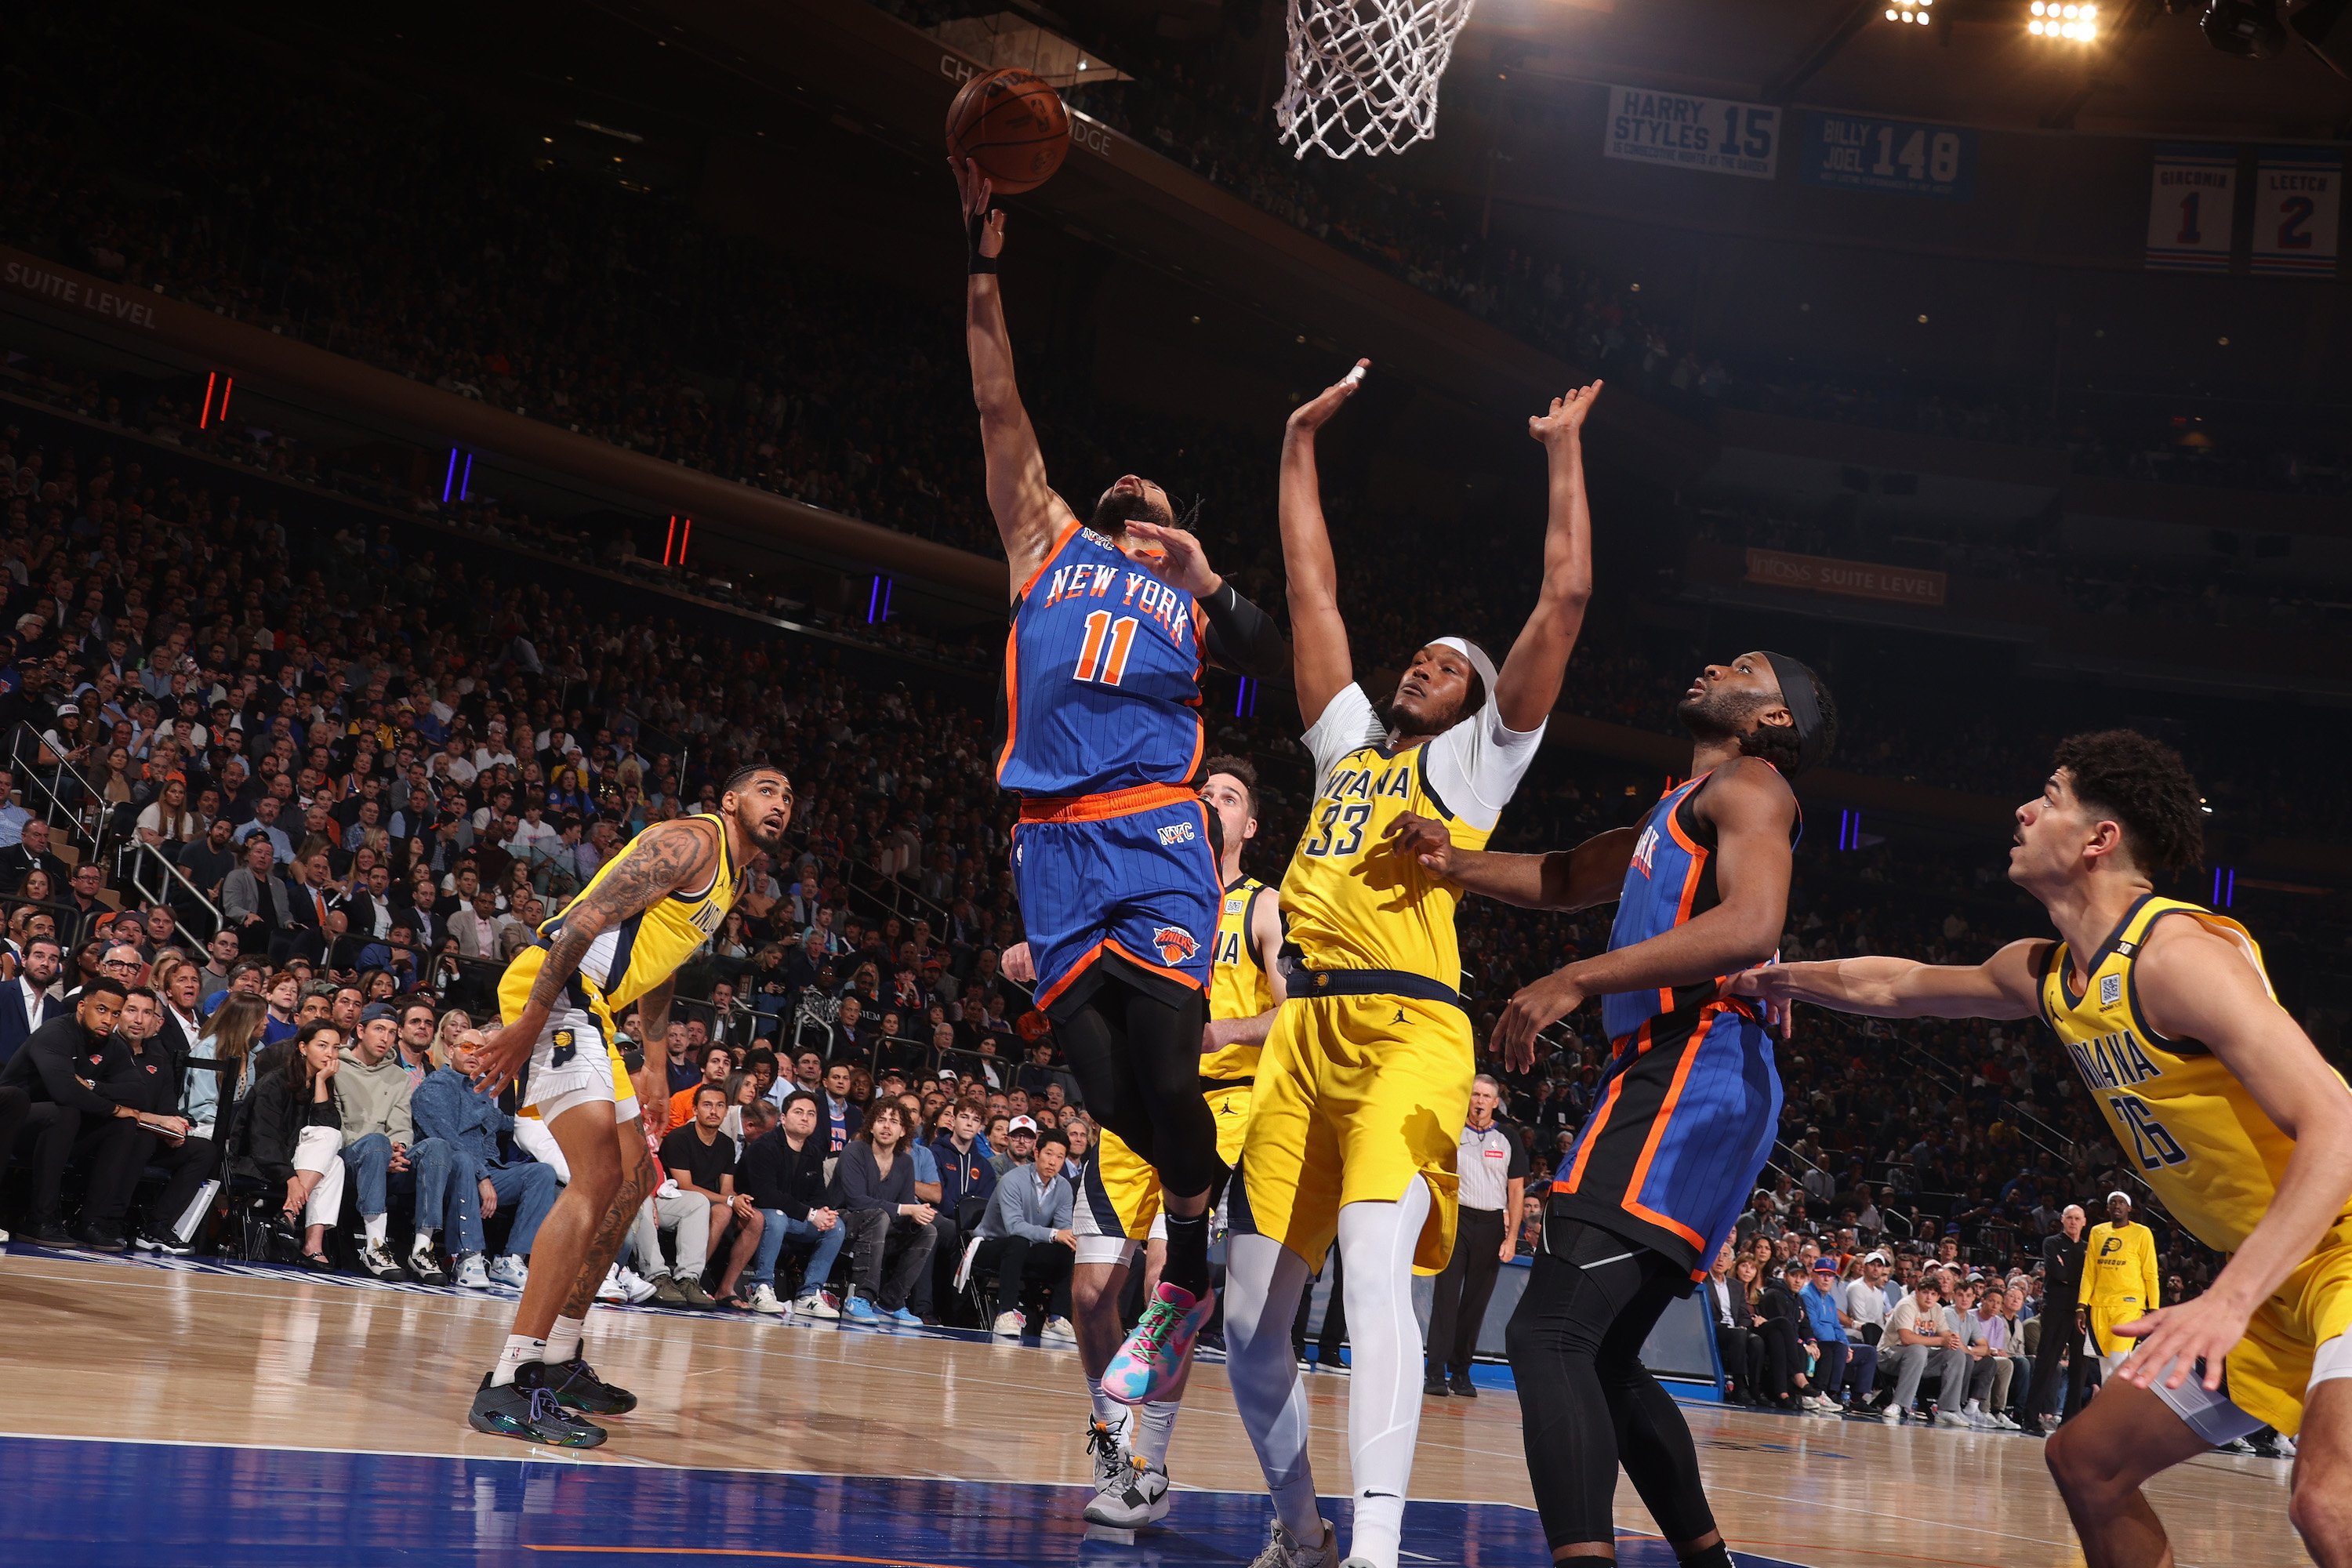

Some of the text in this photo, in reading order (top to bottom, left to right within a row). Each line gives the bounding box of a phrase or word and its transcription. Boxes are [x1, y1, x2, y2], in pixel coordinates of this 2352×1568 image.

[1624, 91, 1704, 123] HARRY
[1614, 115, 1709, 151] STYLES
[1720, 106, 1774, 158] 15
[1823, 119, 1871, 146] BILLY
[1823, 146, 1864, 172] JOEL
[1872, 126, 1960, 182] 148
[2160, 171, 2227, 188] GIACOMIN
[2270, 175, 2328, 191] LEETCH
[2177, 192, 2201, 244] 1
[2278, 196, 2314, 249] 2
[4, 262, 155, 329] SUITE LEVEL
[1081, 527, 1115, 550] NYC
[1751, 553, 1937, 597] Infosys SUITE LEVEL
[1045, 564, 1189, 646] NEW YORK
[1073, 609, 1139, 687] 11
[1157, 822, 1195, 845] NYC
[1304, 803, 1373, 858] 33
[1155, 930, 1194, 956] KNICKS
[2117, 942, 2133, 955] 30
[2109, 1094, 2189, 1171] 26
